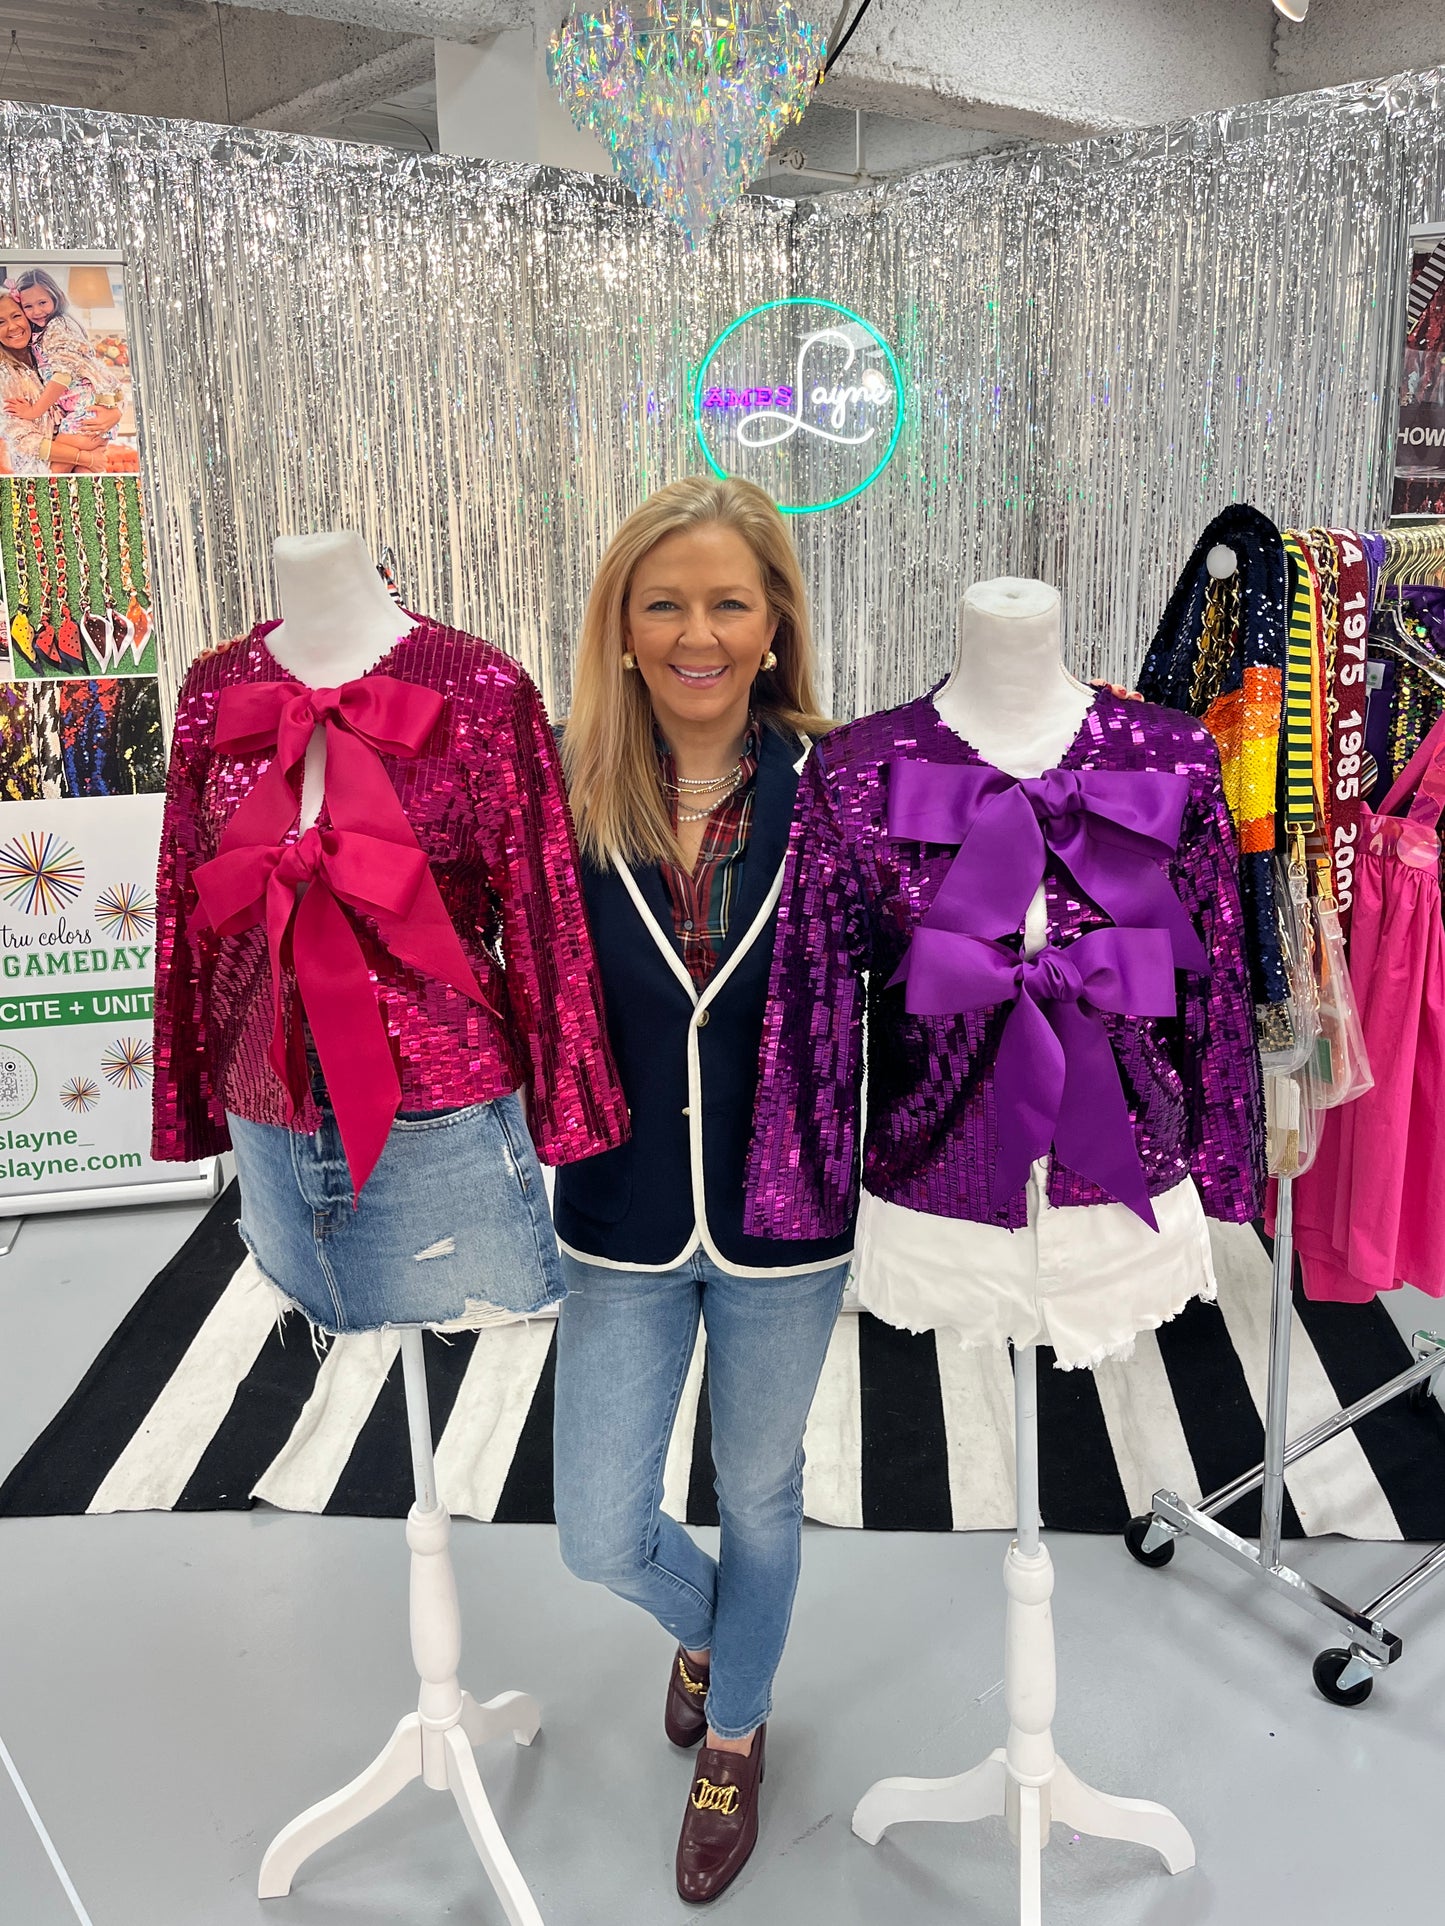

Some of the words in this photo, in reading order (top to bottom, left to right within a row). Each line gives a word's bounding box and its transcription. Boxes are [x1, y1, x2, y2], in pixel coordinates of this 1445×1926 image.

[704, 386, 793, 407] AMES
[737, 330, 893, 447] Layne
[1398, 427, 1445, 447] HOW
[1340, 591, 1366, 686] 1975
[1335, 710, 1362, 801] 1985
[1334, 823, 1358, 913] 2000
[0, 924, 33, 949] tru
[39, 916, 92, 946] colors
[3, 945, 152, 979] GAMEDAY
[0, 1000, 62, 1022] CITE
